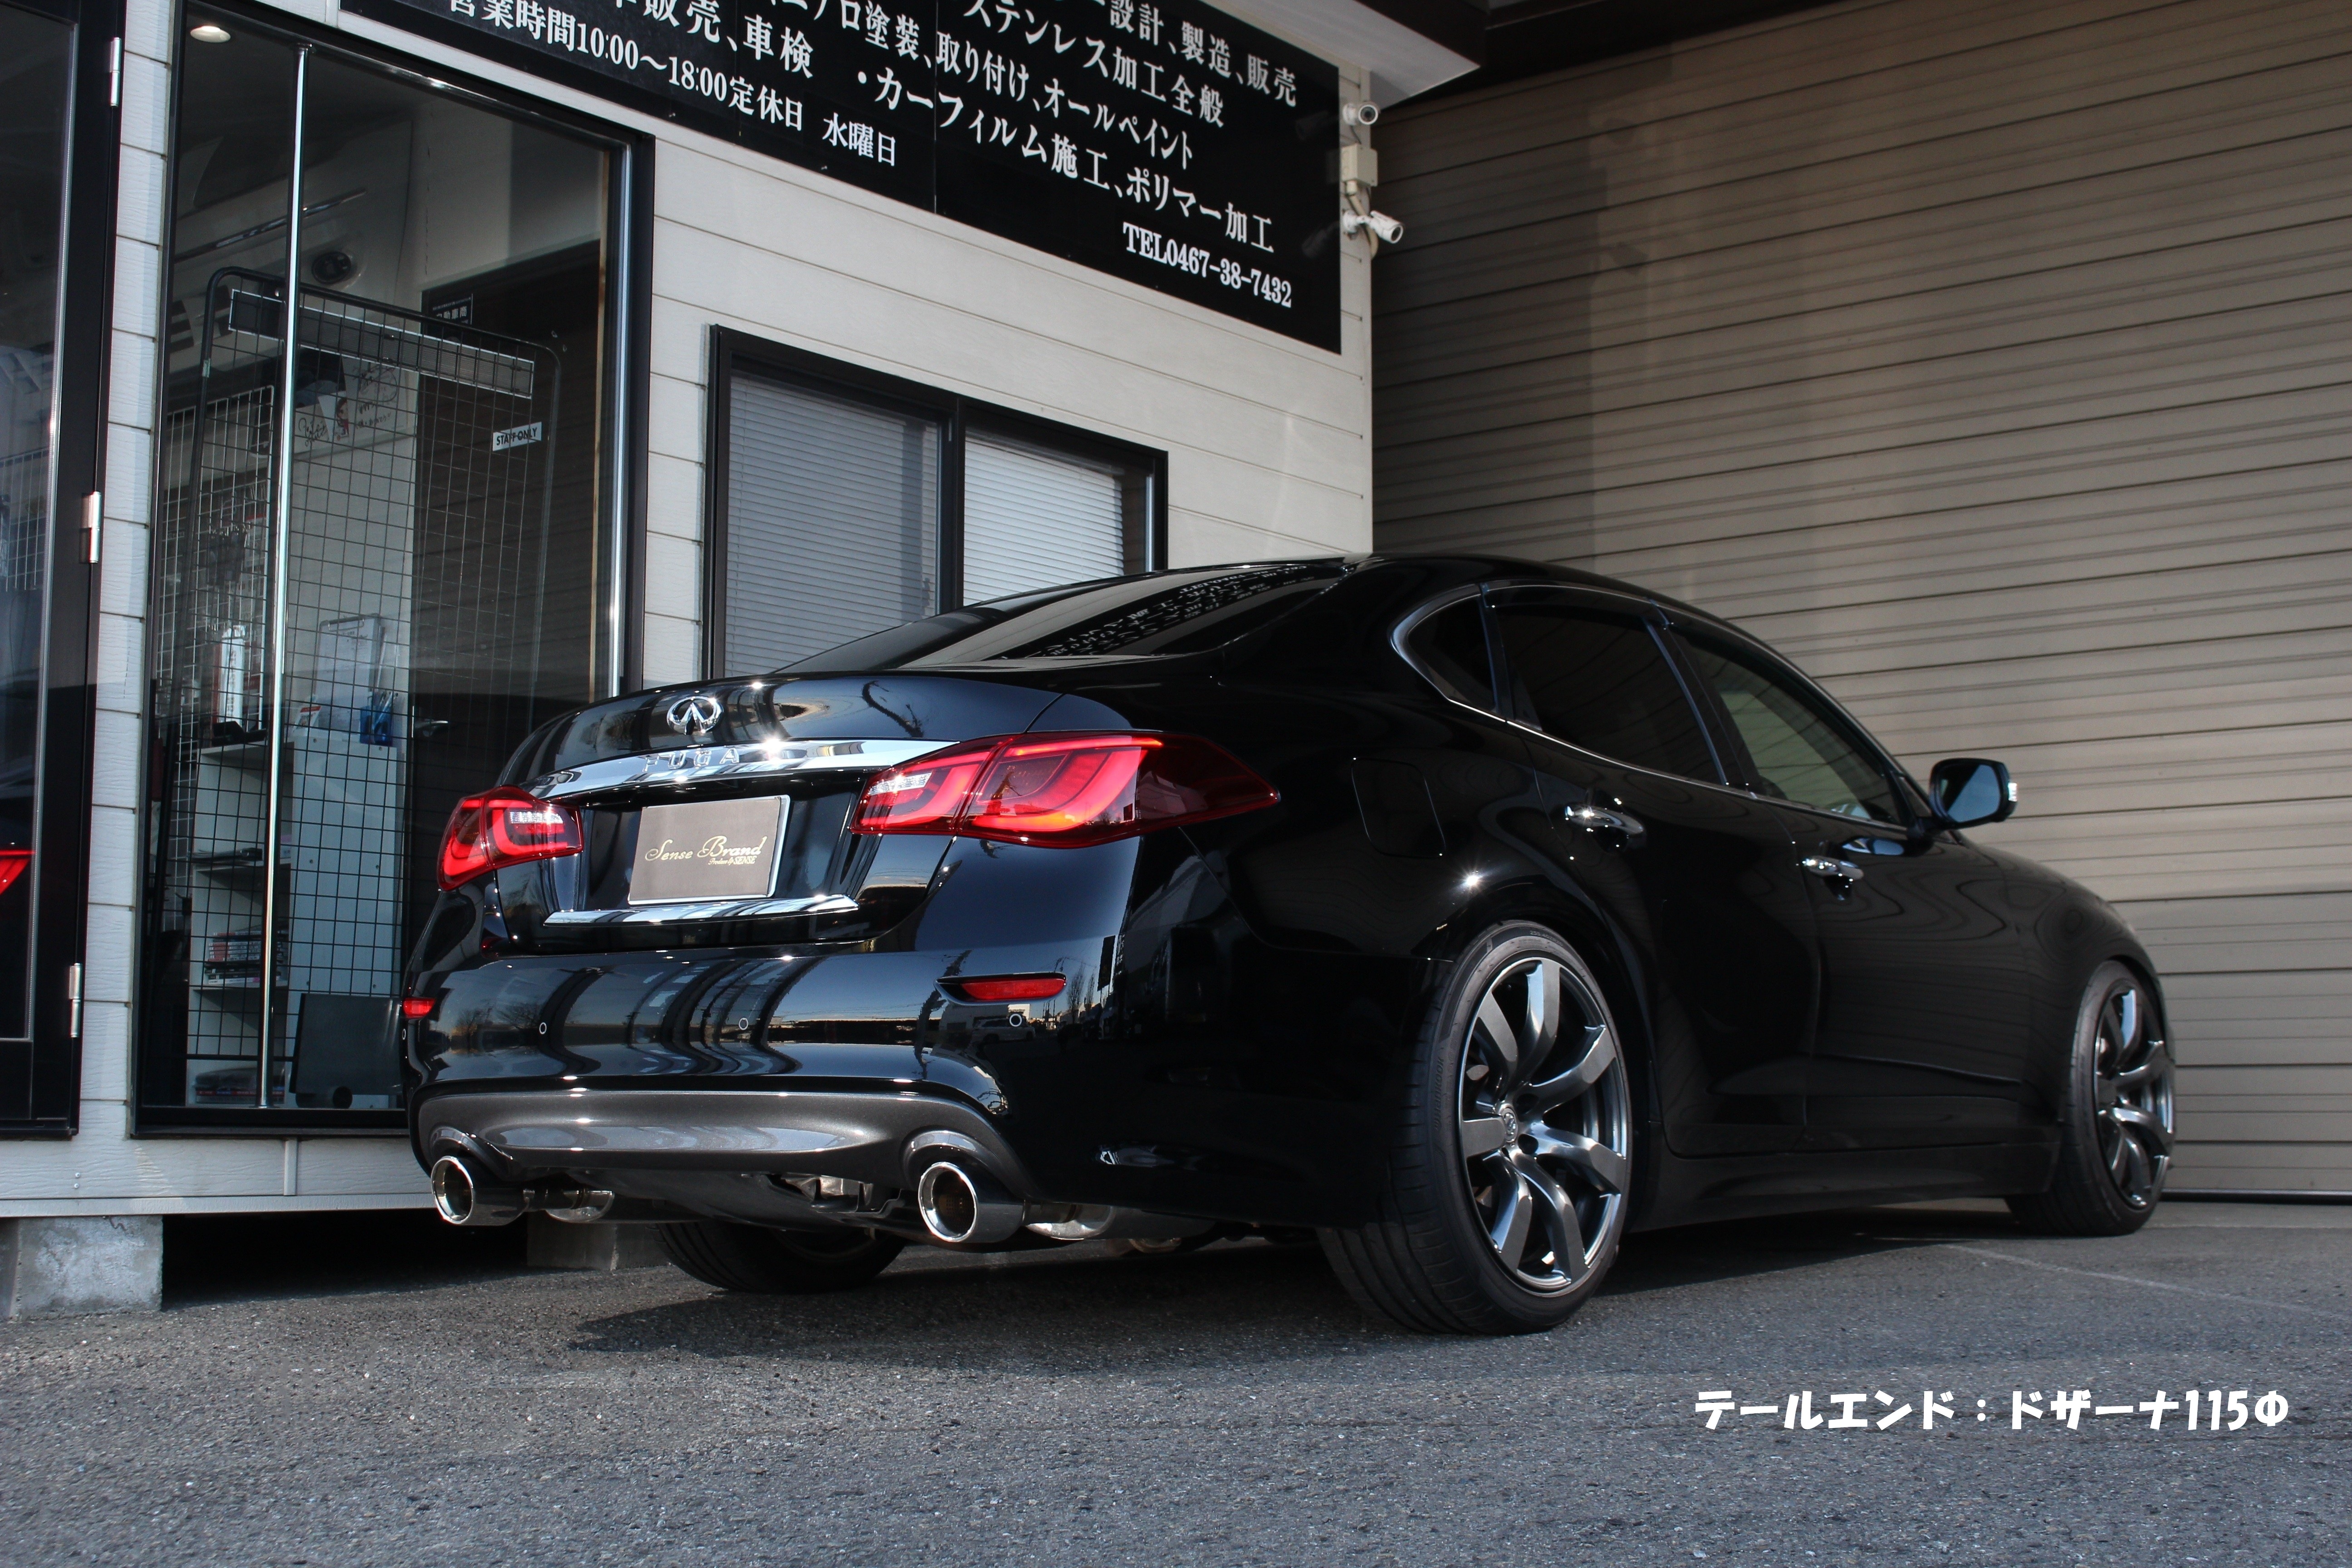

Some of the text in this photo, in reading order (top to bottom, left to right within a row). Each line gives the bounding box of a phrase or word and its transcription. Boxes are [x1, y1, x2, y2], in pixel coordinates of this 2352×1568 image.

[616, 0, 813, 78] 販売、車検
[1095, 0, 1296, 107] 設計、製造、販売
[822, 112, 896, 167] 水曜日
[1122, 221, 1292, 308] TEL0467-38-7432
[517, 427, 538, 441] ONLY
[642, 748, 740, 772] FUGA
[645, 835, 768, 862] Sense Brand
[734, 855, 758, 865] SENSE
